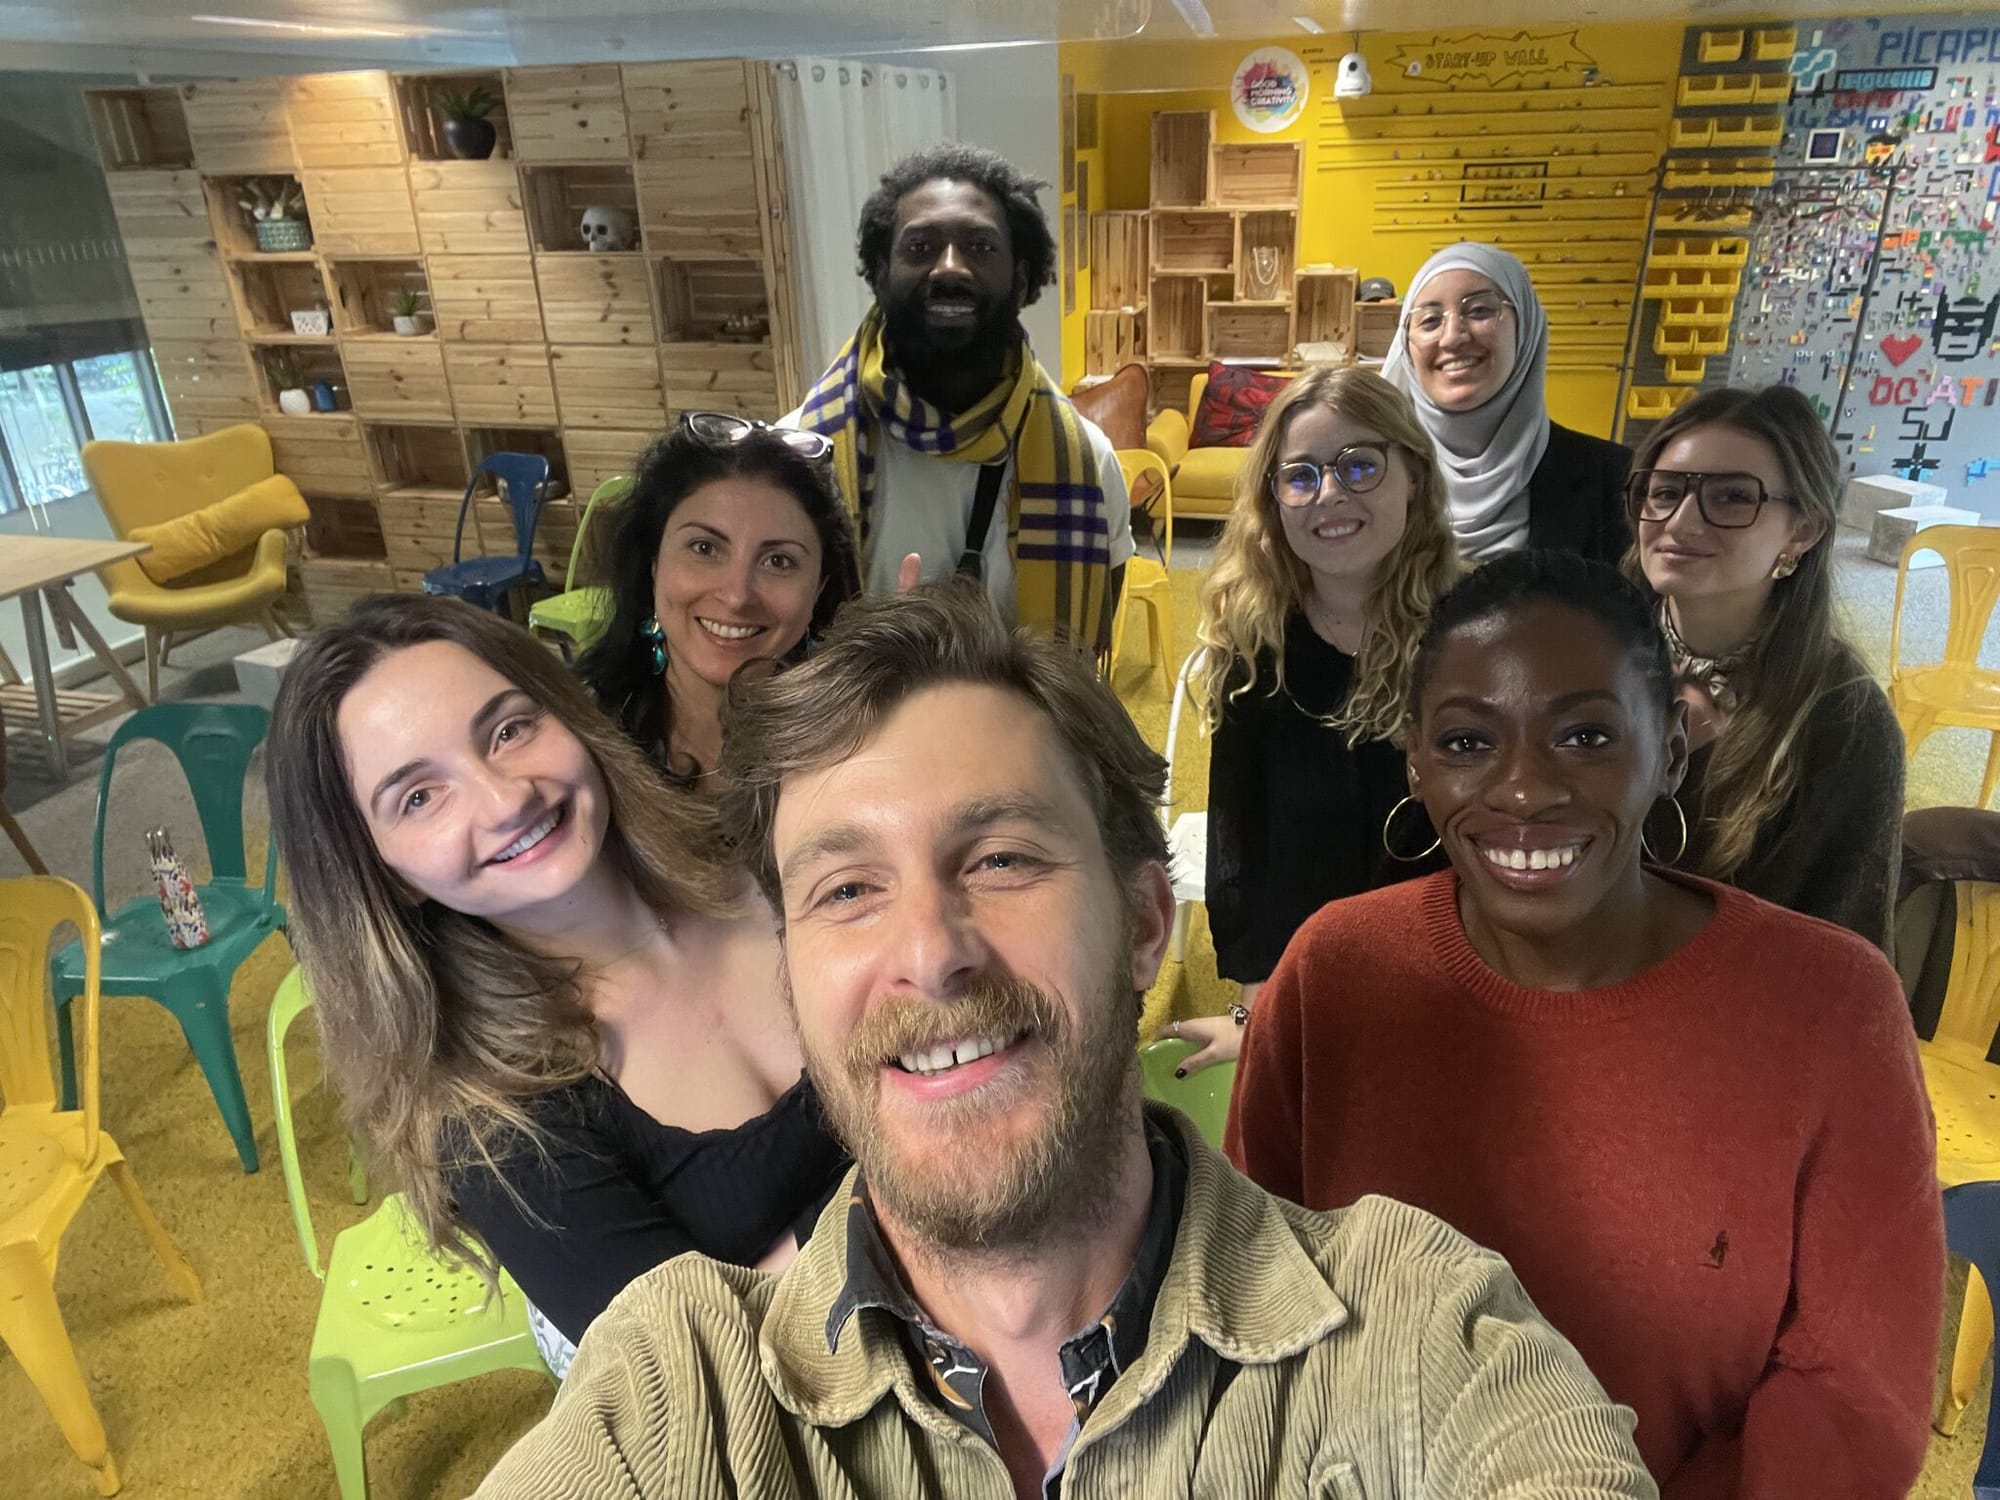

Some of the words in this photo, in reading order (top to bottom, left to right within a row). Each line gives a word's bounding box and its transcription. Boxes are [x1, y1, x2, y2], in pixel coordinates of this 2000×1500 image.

[1425, 51, 1497, 69] START-UP
[1503, 48, 1549, 66] WALL
[1250, 79, 1278, 89] GOOD
[1250, 87, 1293, 97] MORNING
[1250, 96, 1297, 106] CREATIVITY
